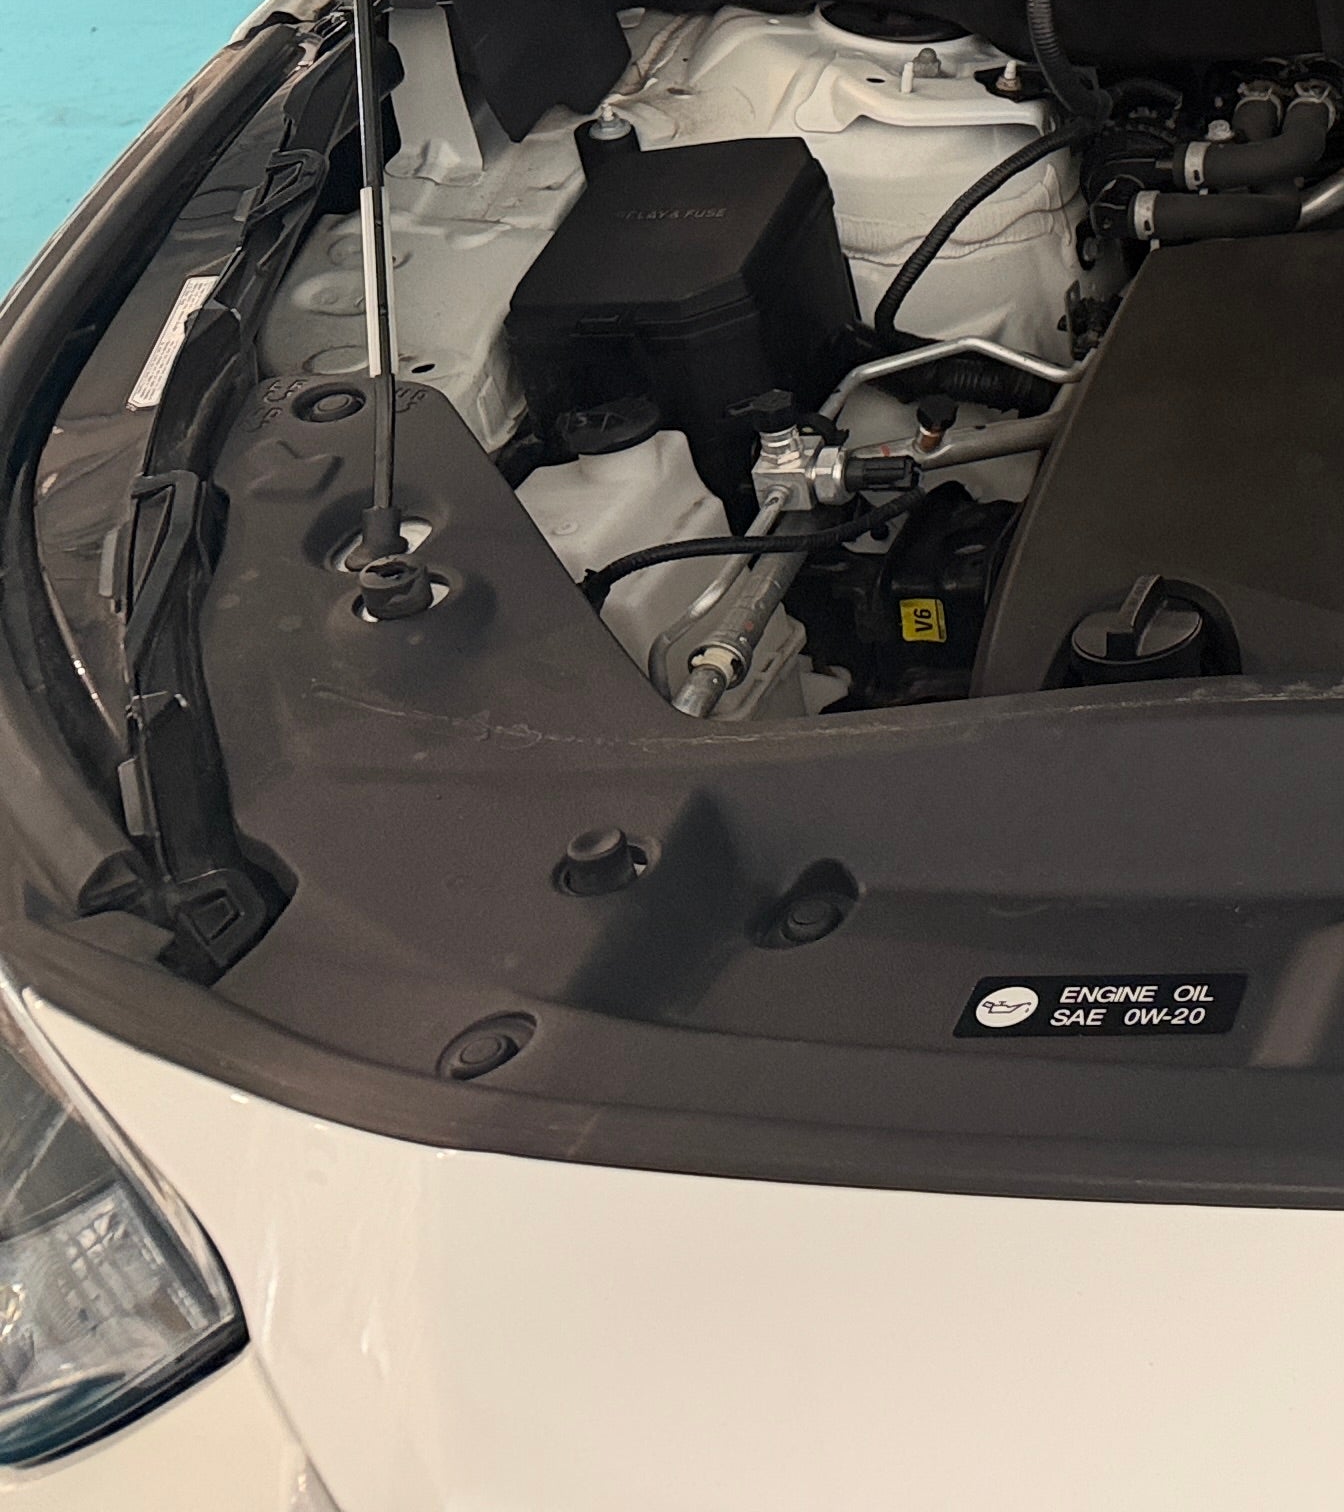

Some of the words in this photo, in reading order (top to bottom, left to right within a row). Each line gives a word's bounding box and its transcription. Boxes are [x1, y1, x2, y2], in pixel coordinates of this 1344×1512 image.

[914, 608, 933, 632] V6
[1060, 986, 1158, 1003] ENGINE
[1173, 986, 1214, 1001] OIL
[1050, 1009, 1106, 1026] SAE
[1124, 1007, 1206, 1026] 0W-20
